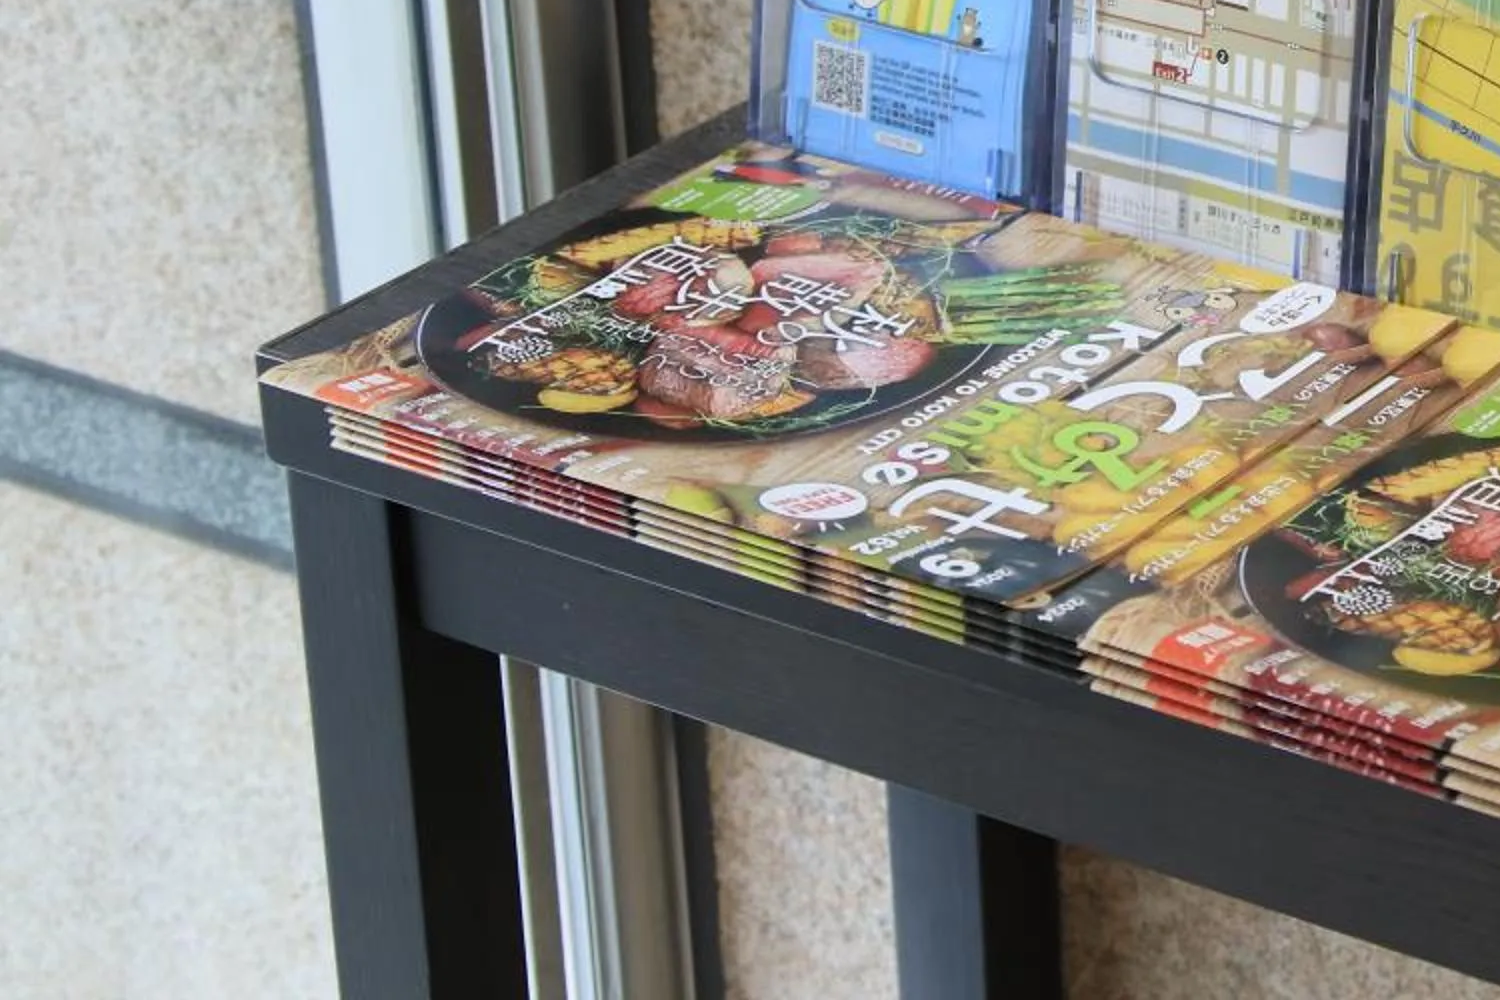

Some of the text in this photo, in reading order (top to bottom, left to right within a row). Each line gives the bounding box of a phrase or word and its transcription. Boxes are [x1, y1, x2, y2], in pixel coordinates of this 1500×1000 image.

[629, 239, 920, 355] 秋の散歩道
[851, 329, 1070, 454] WELCOME TO KOTO CITY
[887, 332, 1316, 543] ことみせ
[920, 552, 981, 582] 9
